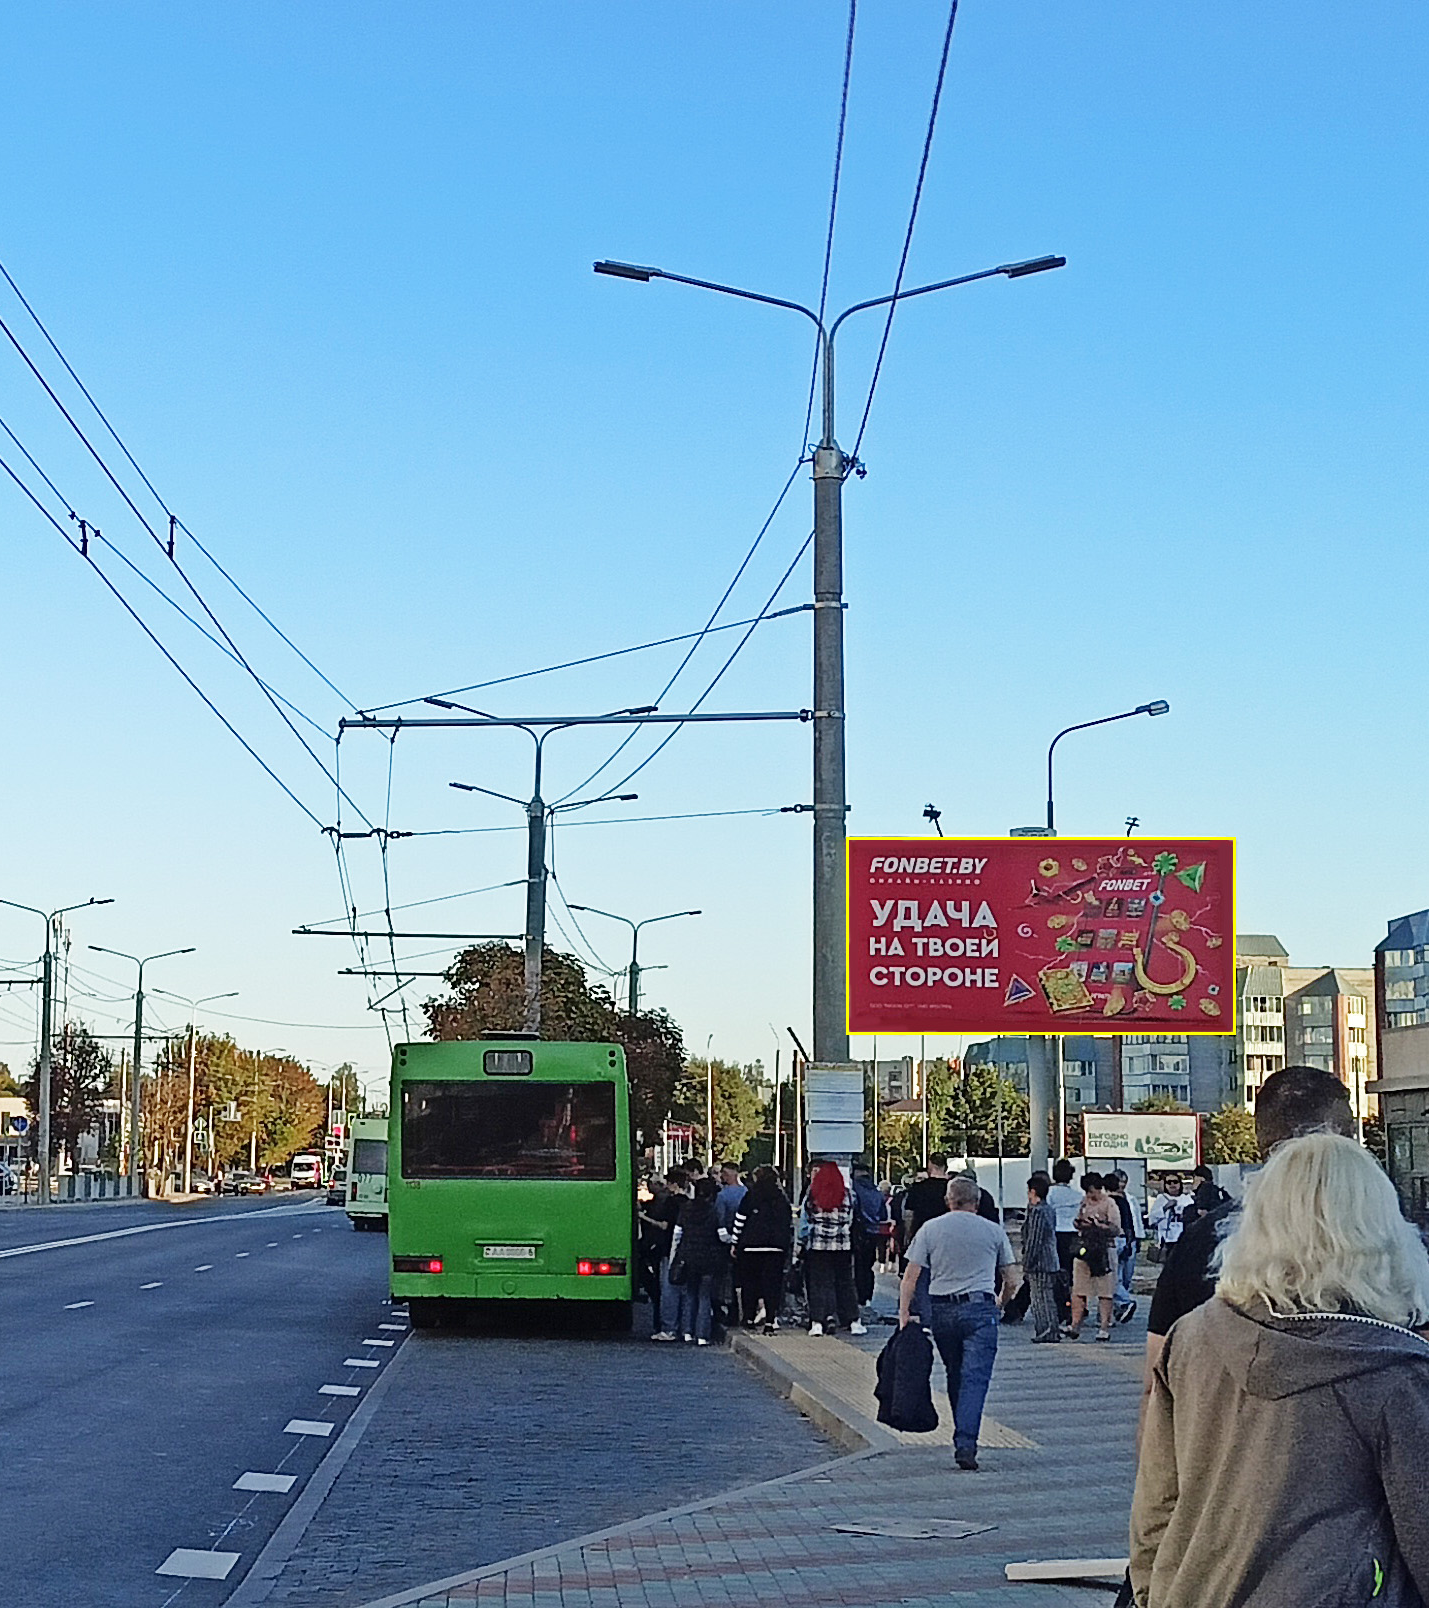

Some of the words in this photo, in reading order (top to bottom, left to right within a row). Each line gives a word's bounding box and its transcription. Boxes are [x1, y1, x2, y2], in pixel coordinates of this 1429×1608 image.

[870, 857, 988, 874] FONBET.BY
[1099, 878, 1152, 891] FONBET
[870, 899, 998, 932] УДАЧА
[870, 936, 905, 956] НА
[912, 930, 999, 958] ТВОЕЙ
[869, 966, 999, 988] СТОРОНЕ
[1089, 1132, 1128, 1140] ВЫГОДНО
[1089, 1140, 1128, 1148] СЕГОДНЯ
